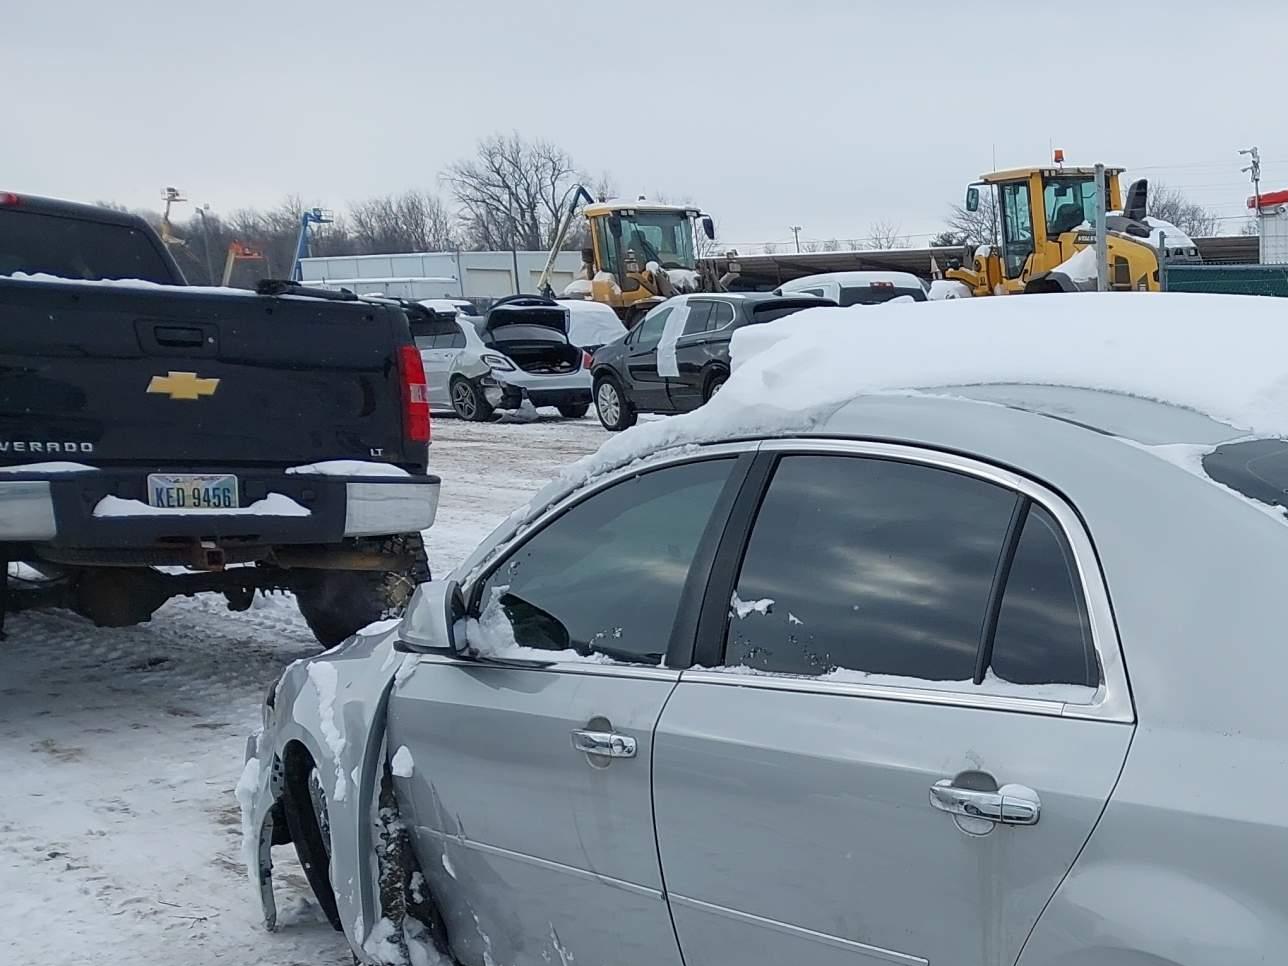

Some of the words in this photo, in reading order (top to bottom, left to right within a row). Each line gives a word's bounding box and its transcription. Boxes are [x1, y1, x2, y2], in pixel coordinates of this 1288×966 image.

[370, 448, 384, 457] LT
[155, 487, 185, 508] KED
[191, 487, 232, 508] 9456
